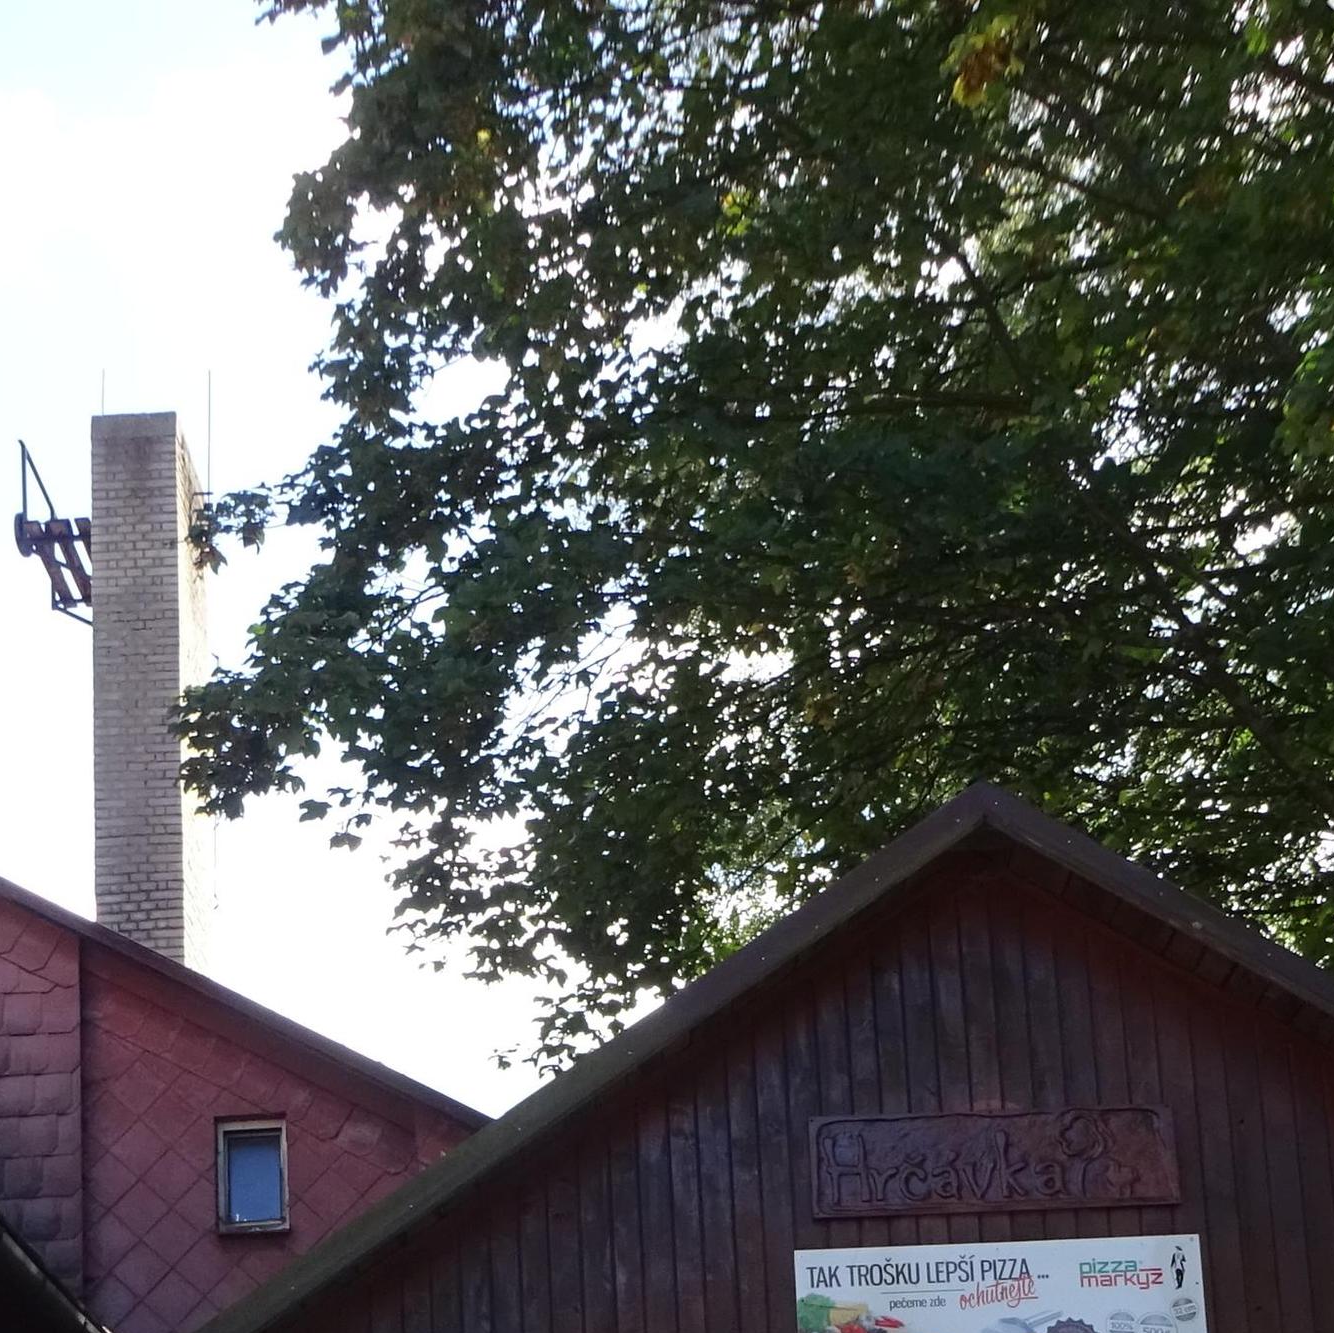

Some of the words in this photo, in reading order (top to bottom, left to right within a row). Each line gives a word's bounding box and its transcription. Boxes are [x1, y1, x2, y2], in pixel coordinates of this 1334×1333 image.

[821, 1126, 1070, 1206] Hrčávka
[806, 1265, 841, 1289] TAK
[846, 1257, 921, 1287] TROŠKU
[926, 1254, 976, 1284] LEPŠÍ
[980, 1257, 1031, 1281] PIZZA
[1079, 1258, 1138, 1275] pizza
[1080, 1268, 1164, 1290] markyz
[889, 1296, 927, 1311] pečeme
[929, 1296, 947, 1308] zde
[958, 1275, 1038, 1310] ochutnejte
